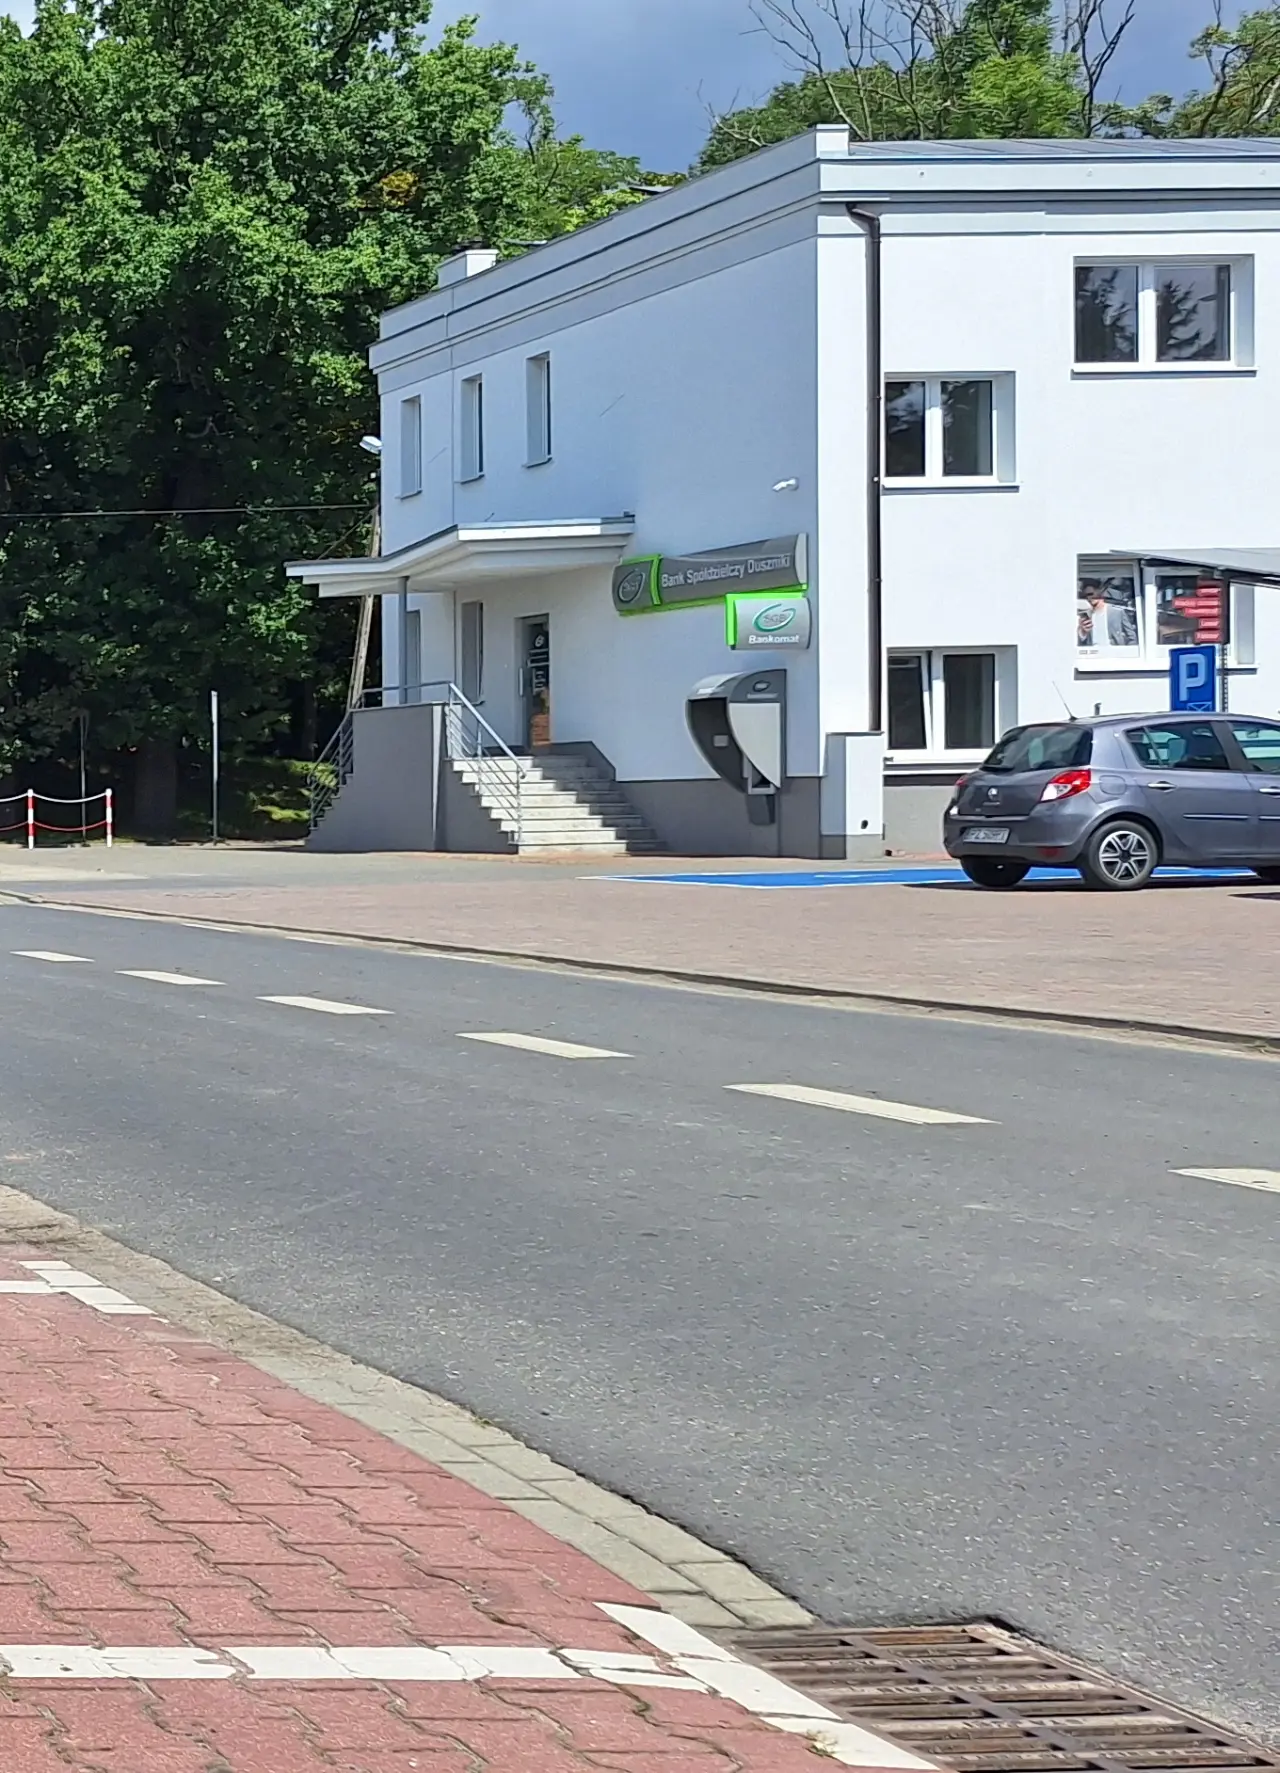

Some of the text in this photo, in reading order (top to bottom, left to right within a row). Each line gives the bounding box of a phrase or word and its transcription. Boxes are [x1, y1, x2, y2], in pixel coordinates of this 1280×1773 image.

[661, 573, 685, 588] Bank
[747, 555, 791, 573] Duszniki
[748, 634, 800, 645] Bankomat
[1179, 654, 1207, 701] P
